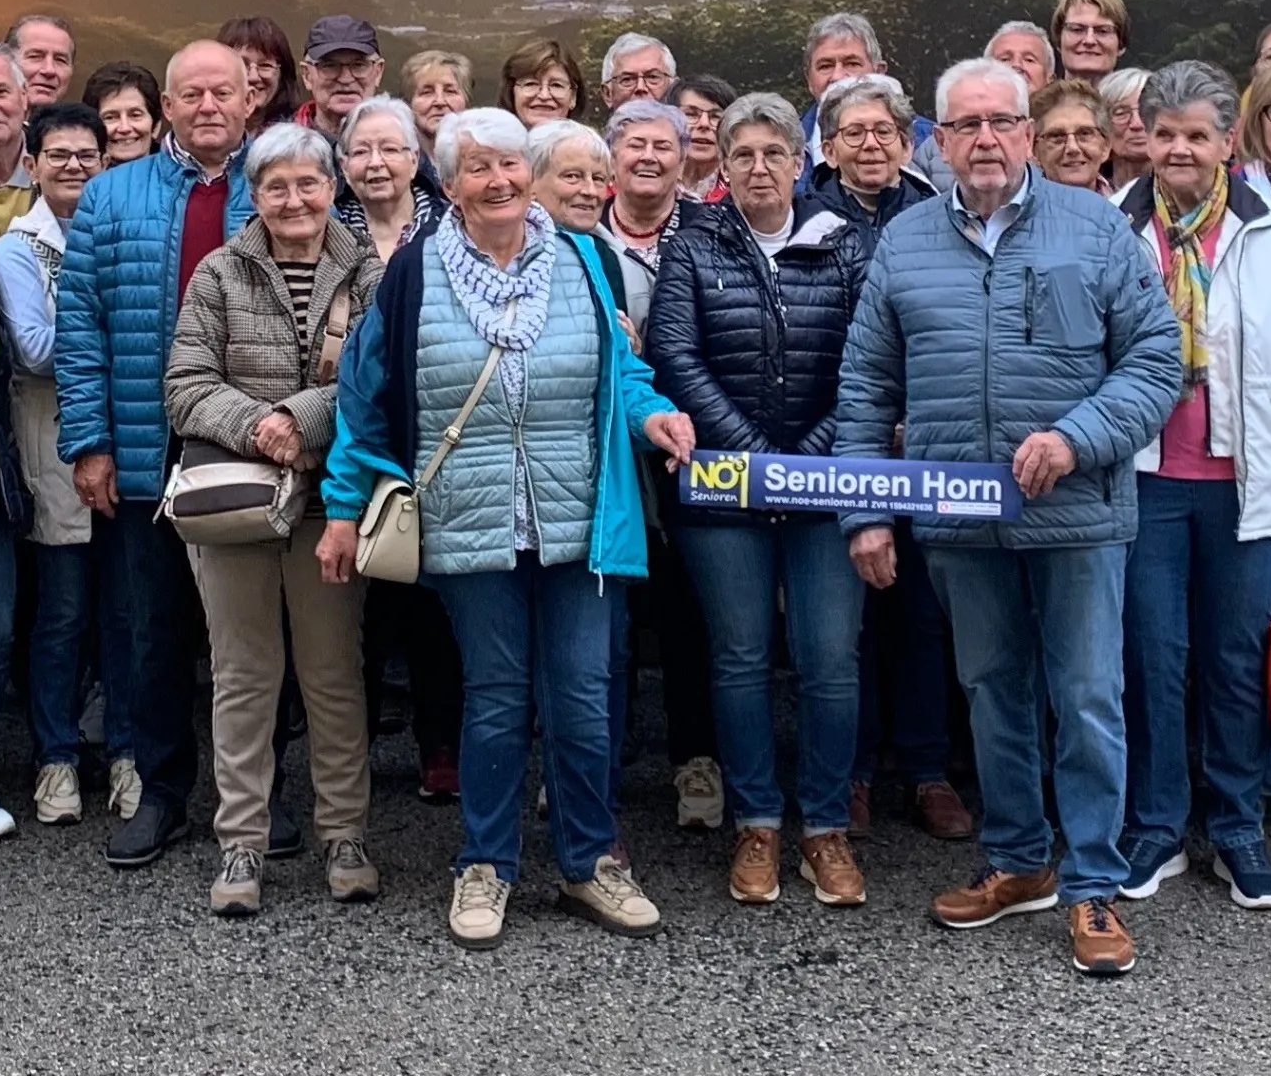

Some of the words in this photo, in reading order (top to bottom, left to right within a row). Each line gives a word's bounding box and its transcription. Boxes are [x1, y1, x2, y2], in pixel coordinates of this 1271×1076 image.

[764, 463, 911, 498] Senioren
[923, 470, 1003, 501] Horn
[690, 490, 738, 503] Senioren
